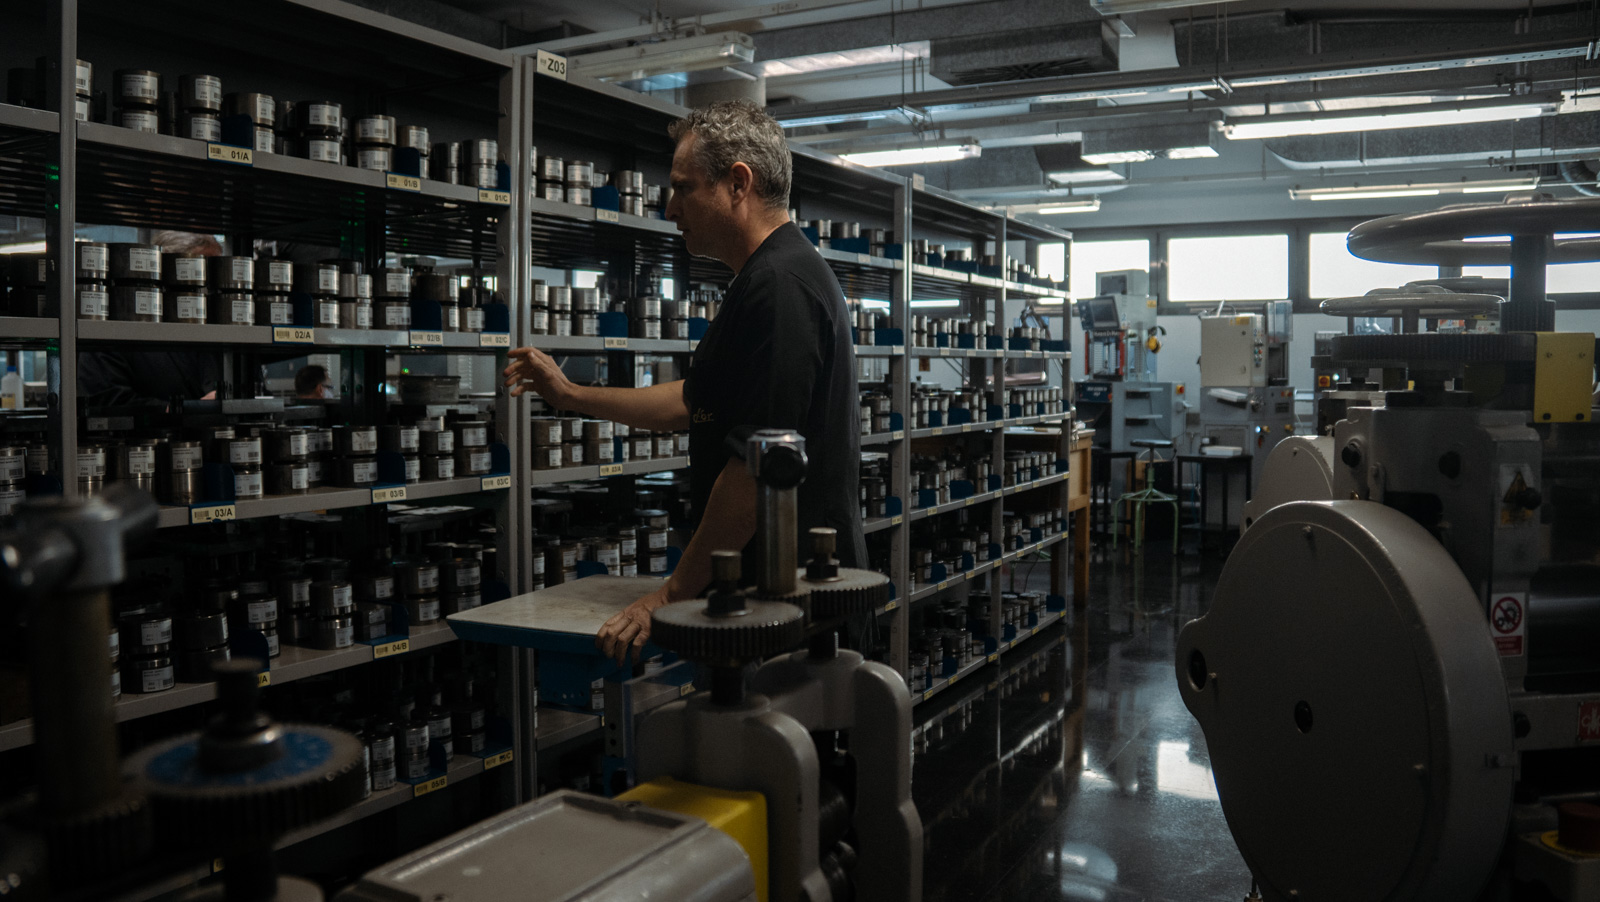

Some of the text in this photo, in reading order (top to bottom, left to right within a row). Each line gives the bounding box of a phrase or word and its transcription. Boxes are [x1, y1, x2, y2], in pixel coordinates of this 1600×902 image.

[547, 58, 566, 75] Z03
[231, 150, 249, 161] 01/A
[403, 179, 418, 188] 01/B
[494, 194, 508, 202] 01/C
[294, 330, 311, 339] 02/A
[427, 334, 441, 342] 02/B
[497, 477, 509, 486] 03/C
[390, 489, 404, 498] 03/B
[214, 507, 233, 518] 03/A
[392, 642, 407, 652] 04/B
[431, 778, 445, 789] 05/B
